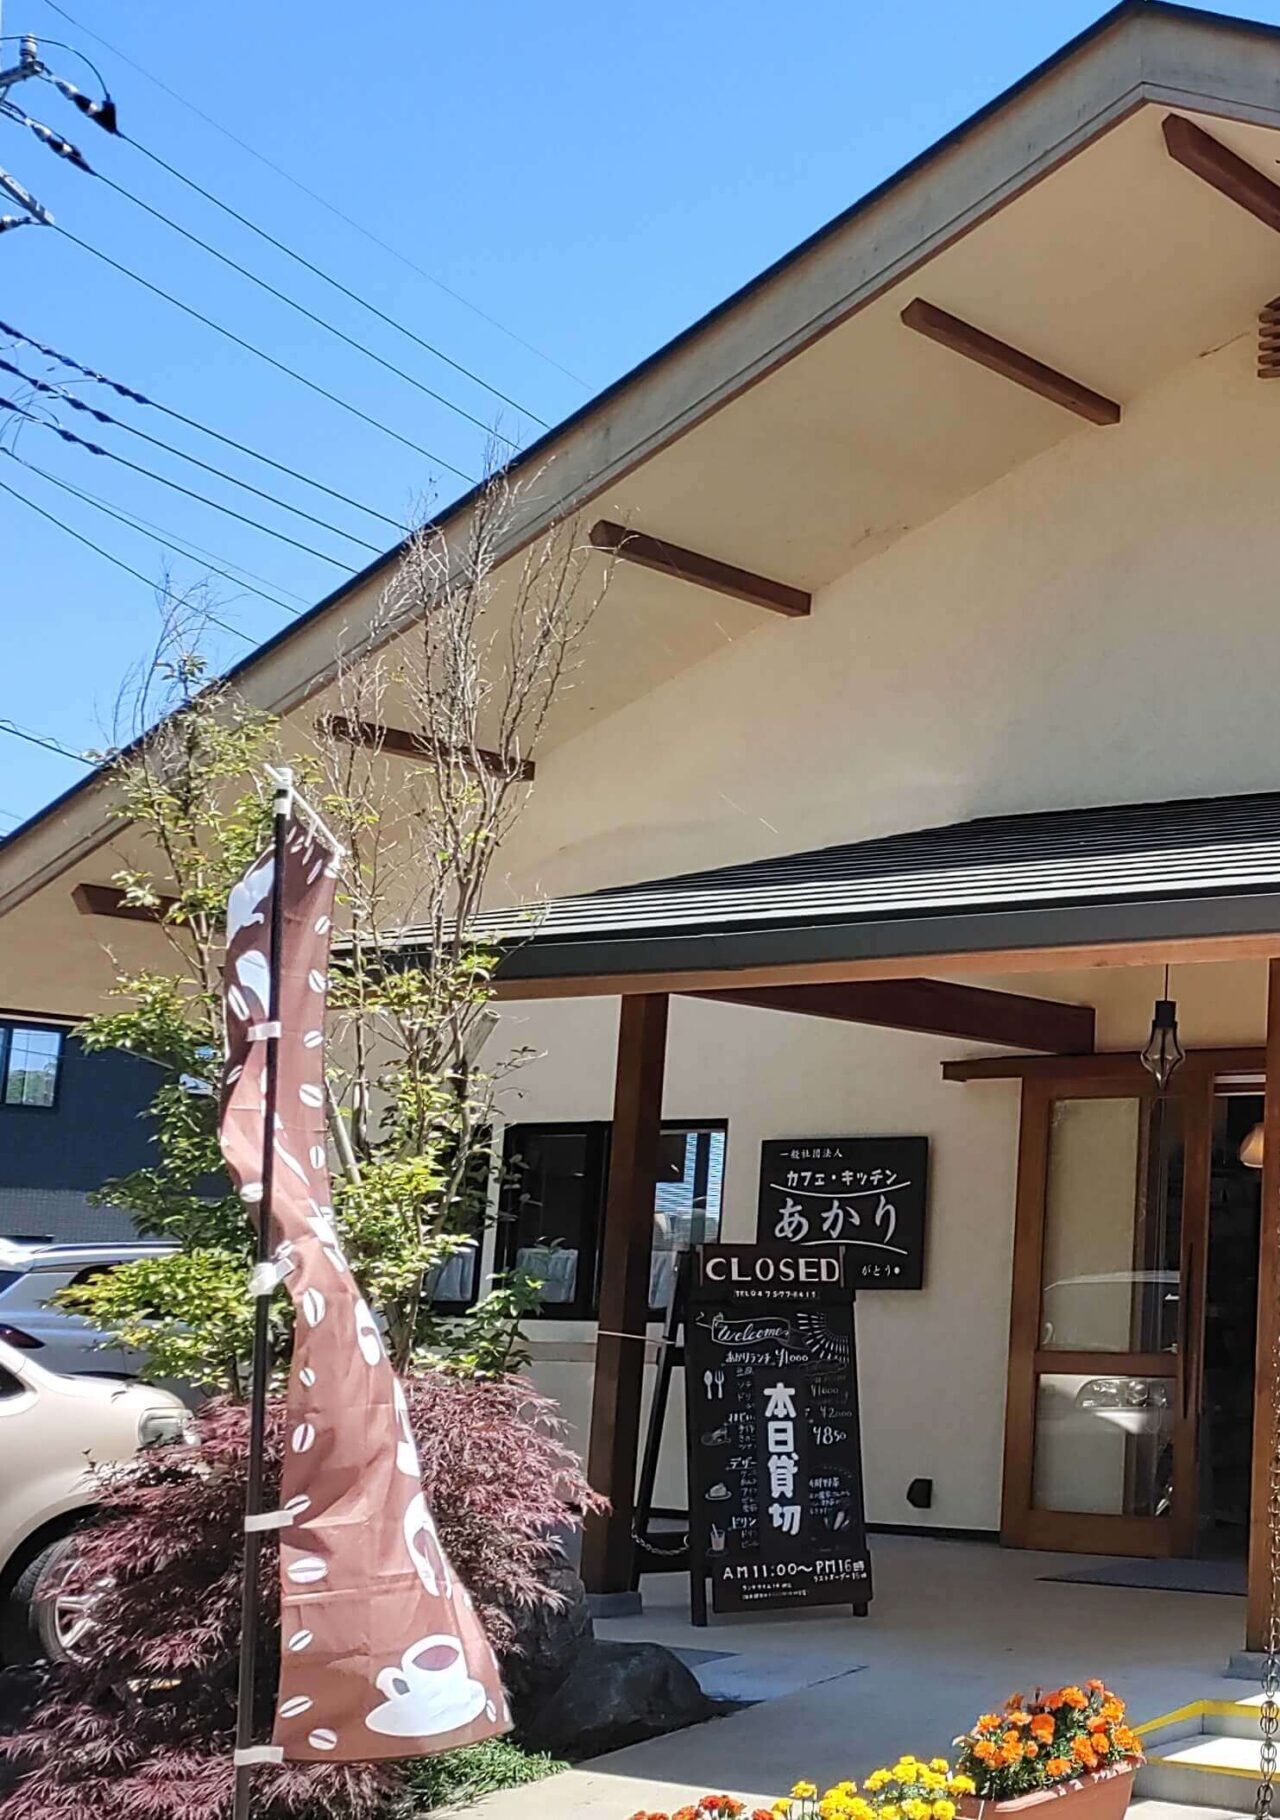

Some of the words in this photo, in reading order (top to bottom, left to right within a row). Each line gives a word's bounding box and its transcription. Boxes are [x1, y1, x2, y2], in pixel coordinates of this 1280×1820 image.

[786, 1169, 897, 1187] カフェ・キッチン
[774, 1195, 897, 1243] あかり
[705, 1257, 839, 1282] CLOSED
[716, 1323, 789, 1341] Welcome
[763, 1382, 801, 1535] 本日貸切
